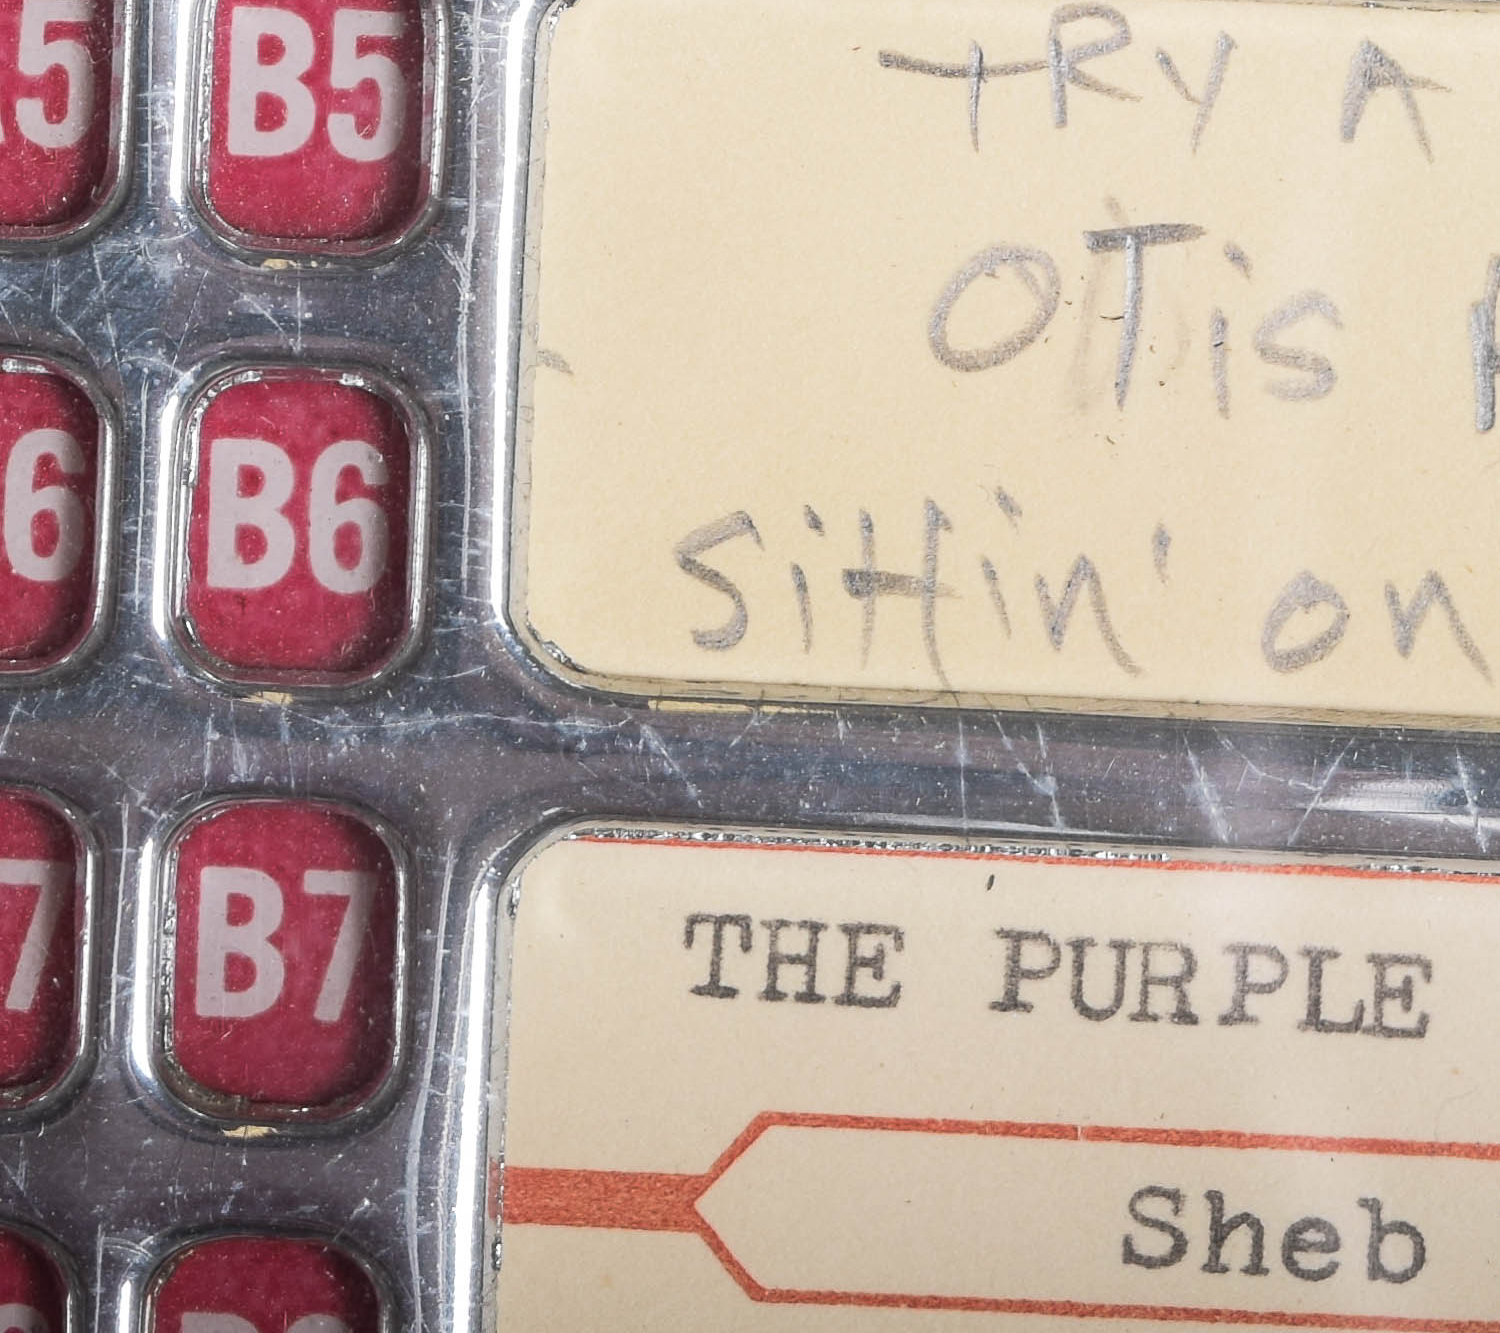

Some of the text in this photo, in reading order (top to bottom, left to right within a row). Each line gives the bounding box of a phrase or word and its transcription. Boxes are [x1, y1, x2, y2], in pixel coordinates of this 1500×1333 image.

[225, 2, 403, 164] B5
[1338, 37, 1456, 164] A
[203, 435, 391, 596] B6
[1256, 566, 1498, 687] on
[194, 863, 376, 1025] B7
[682, 912, 906, 1010] THE
[987, 926, 1434, 1041] PURPLE
[1120, 1184, 1428, 1286] Sheb
